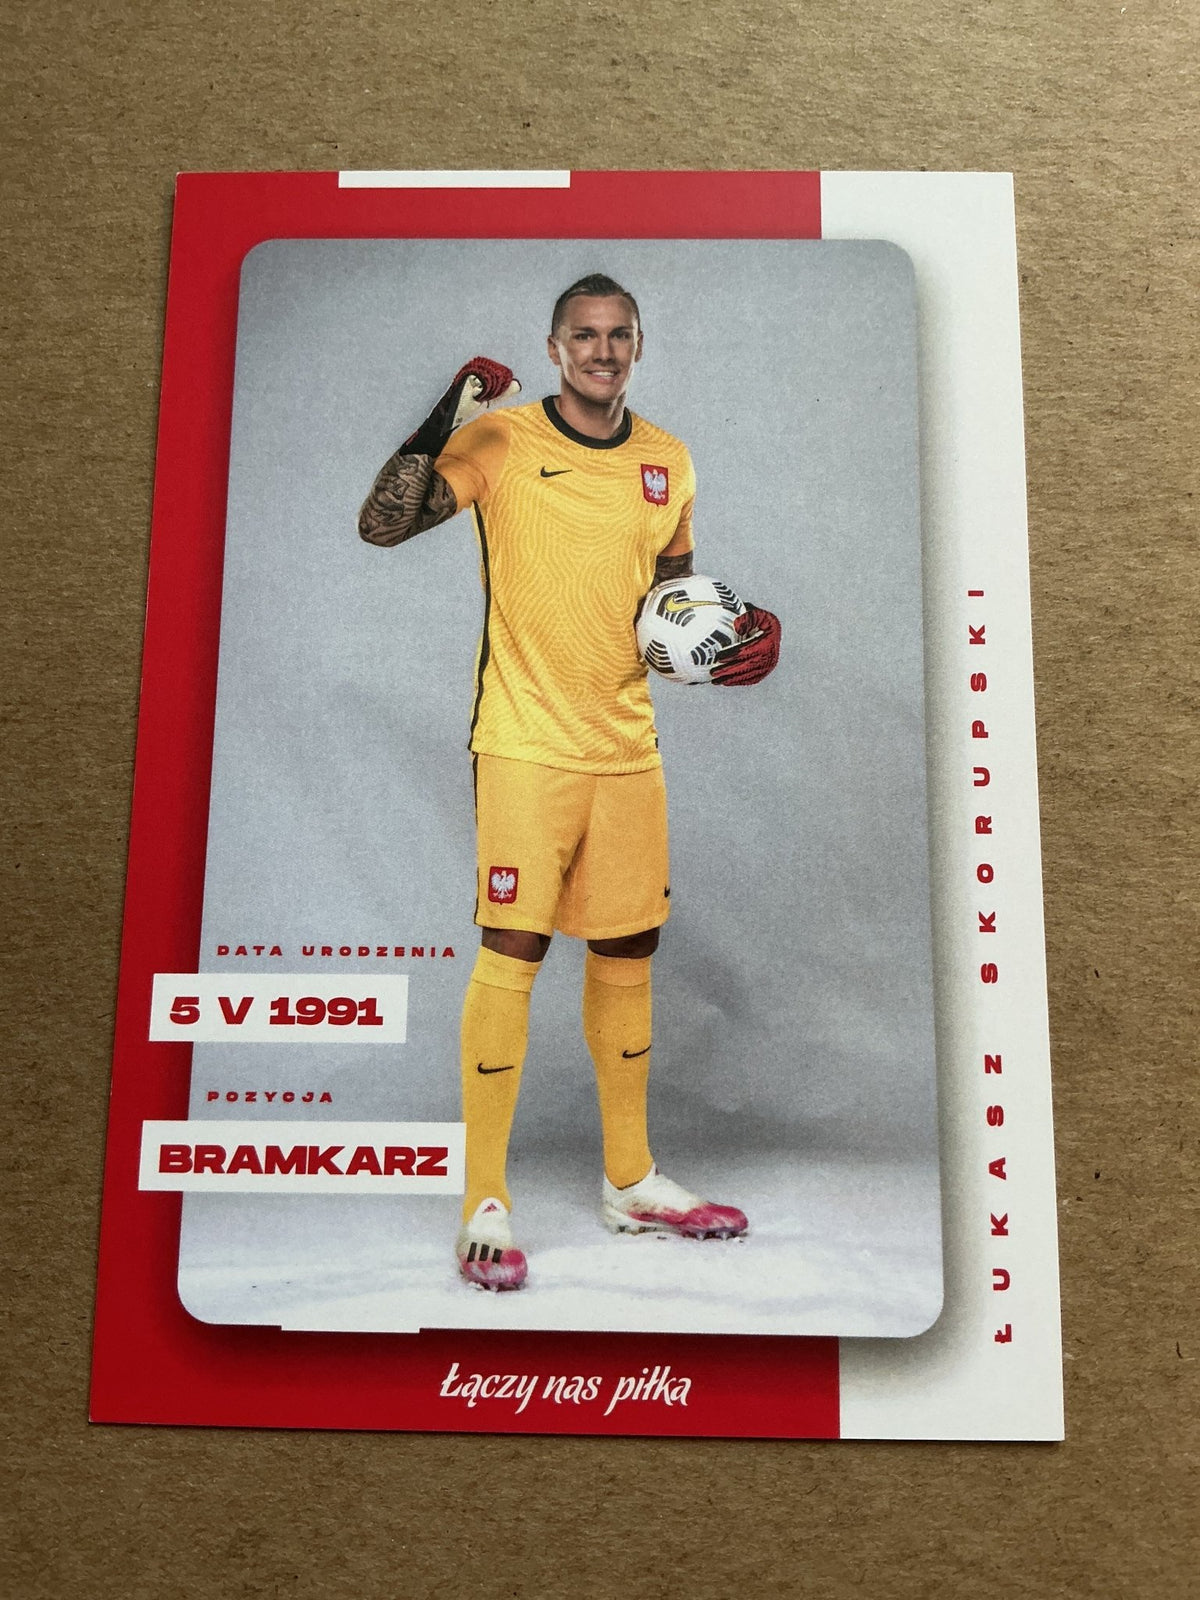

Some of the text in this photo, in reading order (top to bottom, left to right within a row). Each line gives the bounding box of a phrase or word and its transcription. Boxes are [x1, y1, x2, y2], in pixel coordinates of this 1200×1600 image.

[216, 945, 455, 958] DATA URODZENIA
[967, 590, 1012, 1344] ŁUKASZ SKORUPSKI
[169, 996, 384, 1026] 5 V 1991
[206, 1091, 333, 1104] POZYCJA
[158, 1144, 449, 1177] BRAMKARZ
[439, 1362, 692, 1416] Łączy nas piłka
